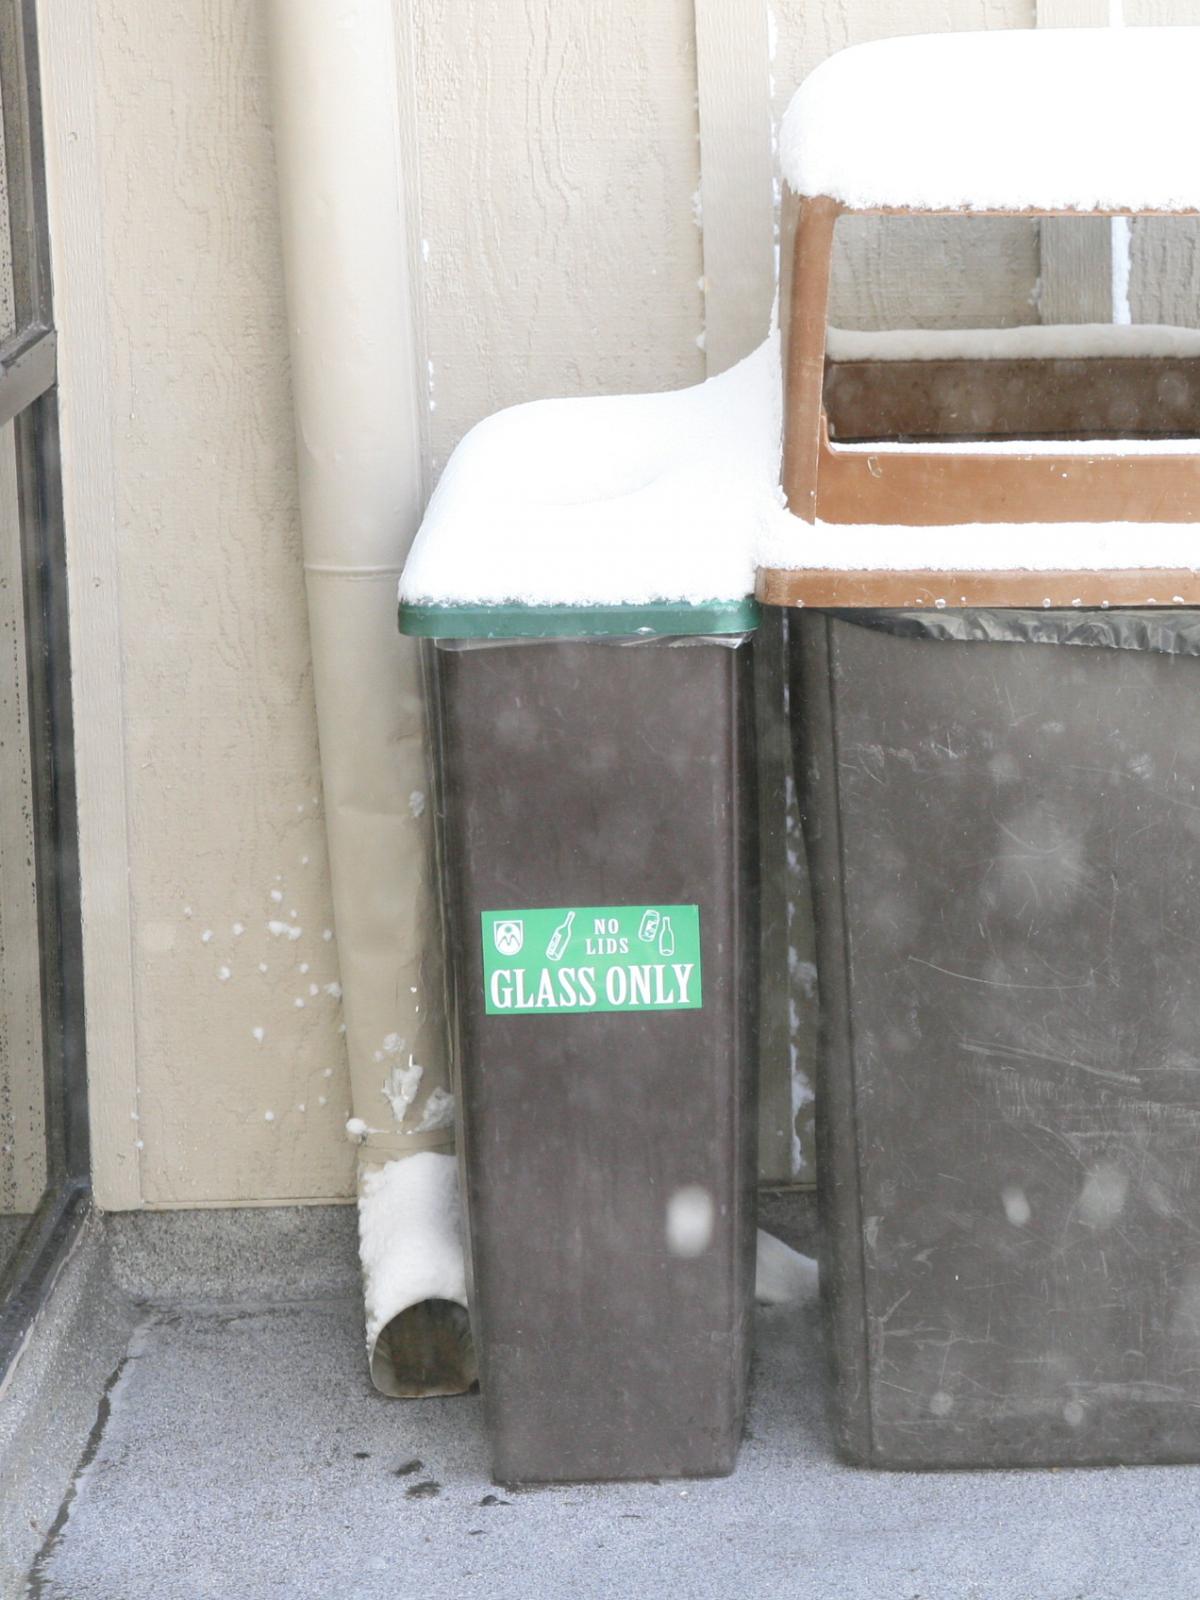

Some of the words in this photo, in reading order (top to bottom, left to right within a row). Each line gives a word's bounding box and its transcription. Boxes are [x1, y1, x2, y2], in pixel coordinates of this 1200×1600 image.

[593, 918, 619, 935] NO
[585, 937, 630, 956] LIDS
[490, 966, 597, 1009] GLASS
[605, 963, 695, 1006] ONLY
